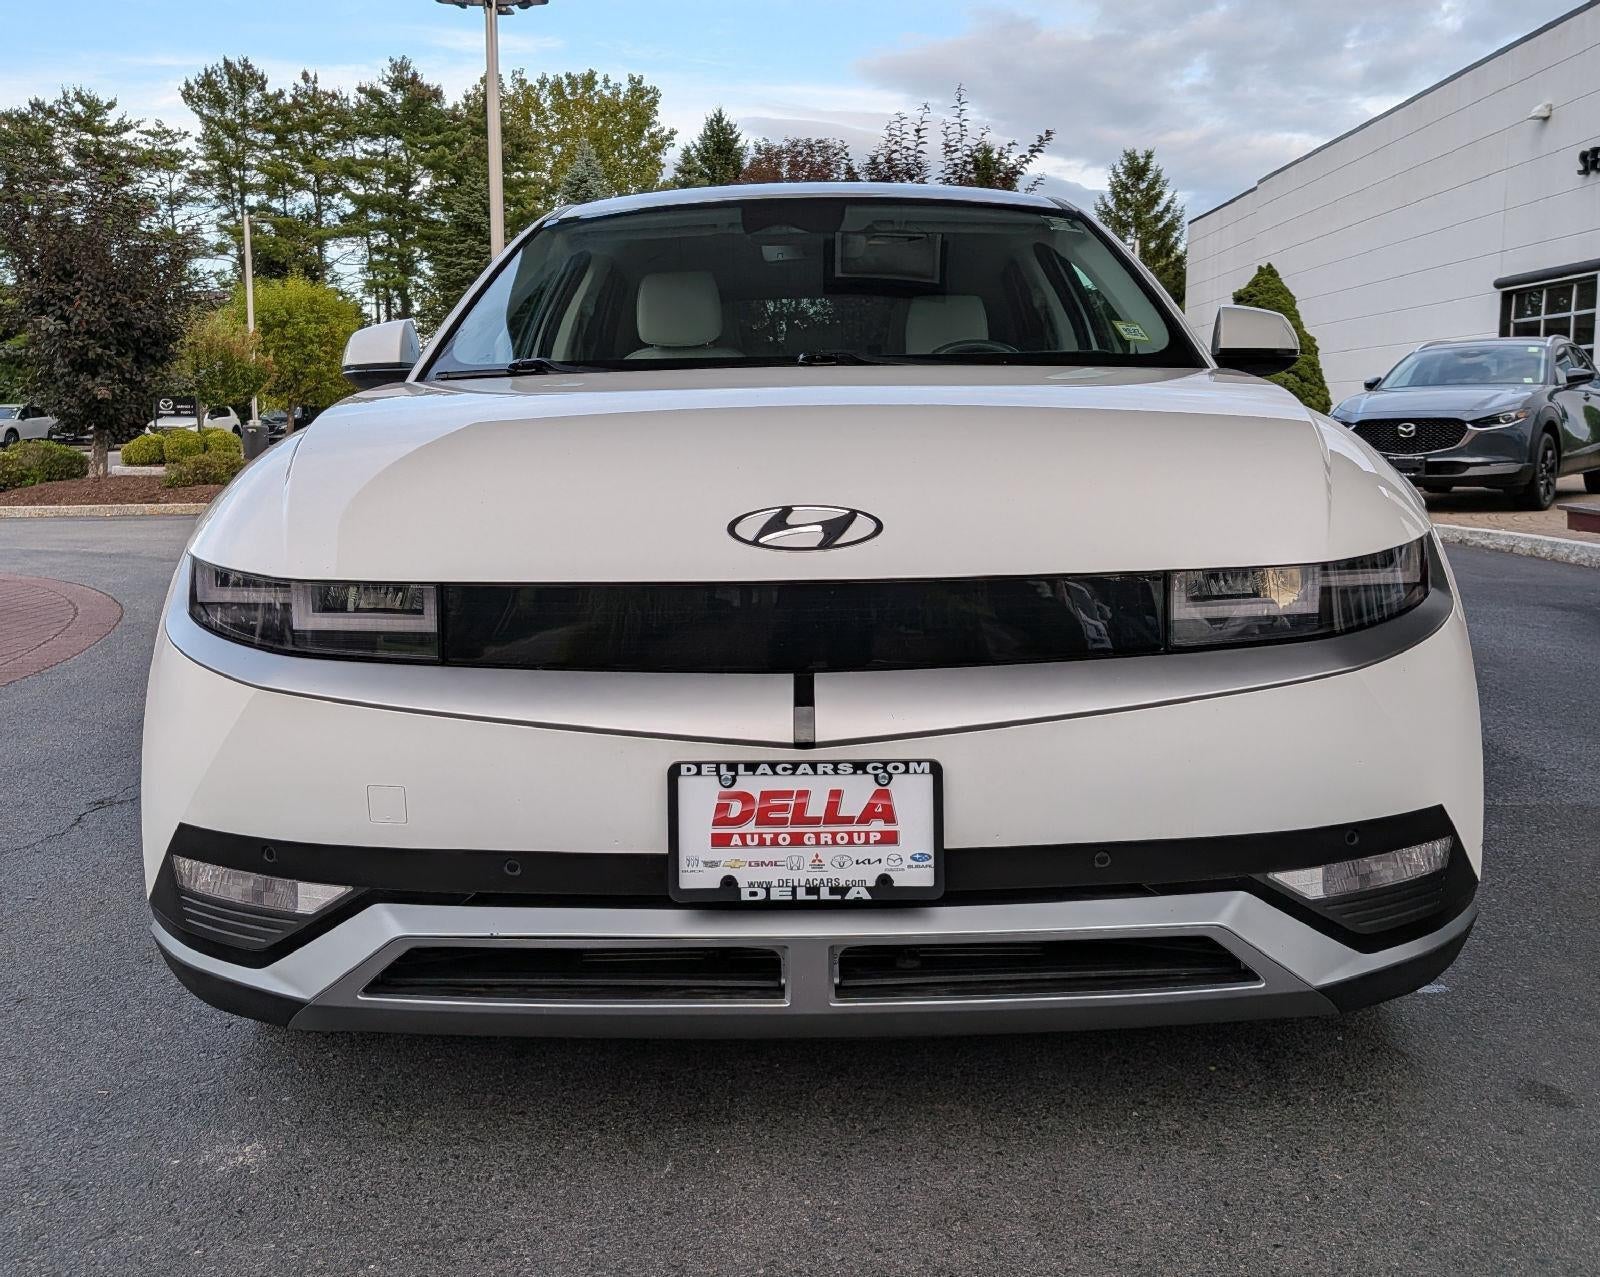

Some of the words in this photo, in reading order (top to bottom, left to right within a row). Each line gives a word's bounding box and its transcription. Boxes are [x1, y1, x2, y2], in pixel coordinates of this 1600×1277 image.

[680, 761, 930, 776] DELLACARS.COM
[711, 787, 898, 829] DELLA
[730, 833, 791, 847] AUTO
[803, 832, 882, 846] GROUP
[748, 860, 786, 868] GMC
[747, 877, 867, 888] www.DELLACARS.com
[740, 886, 872, 900] DELLA
